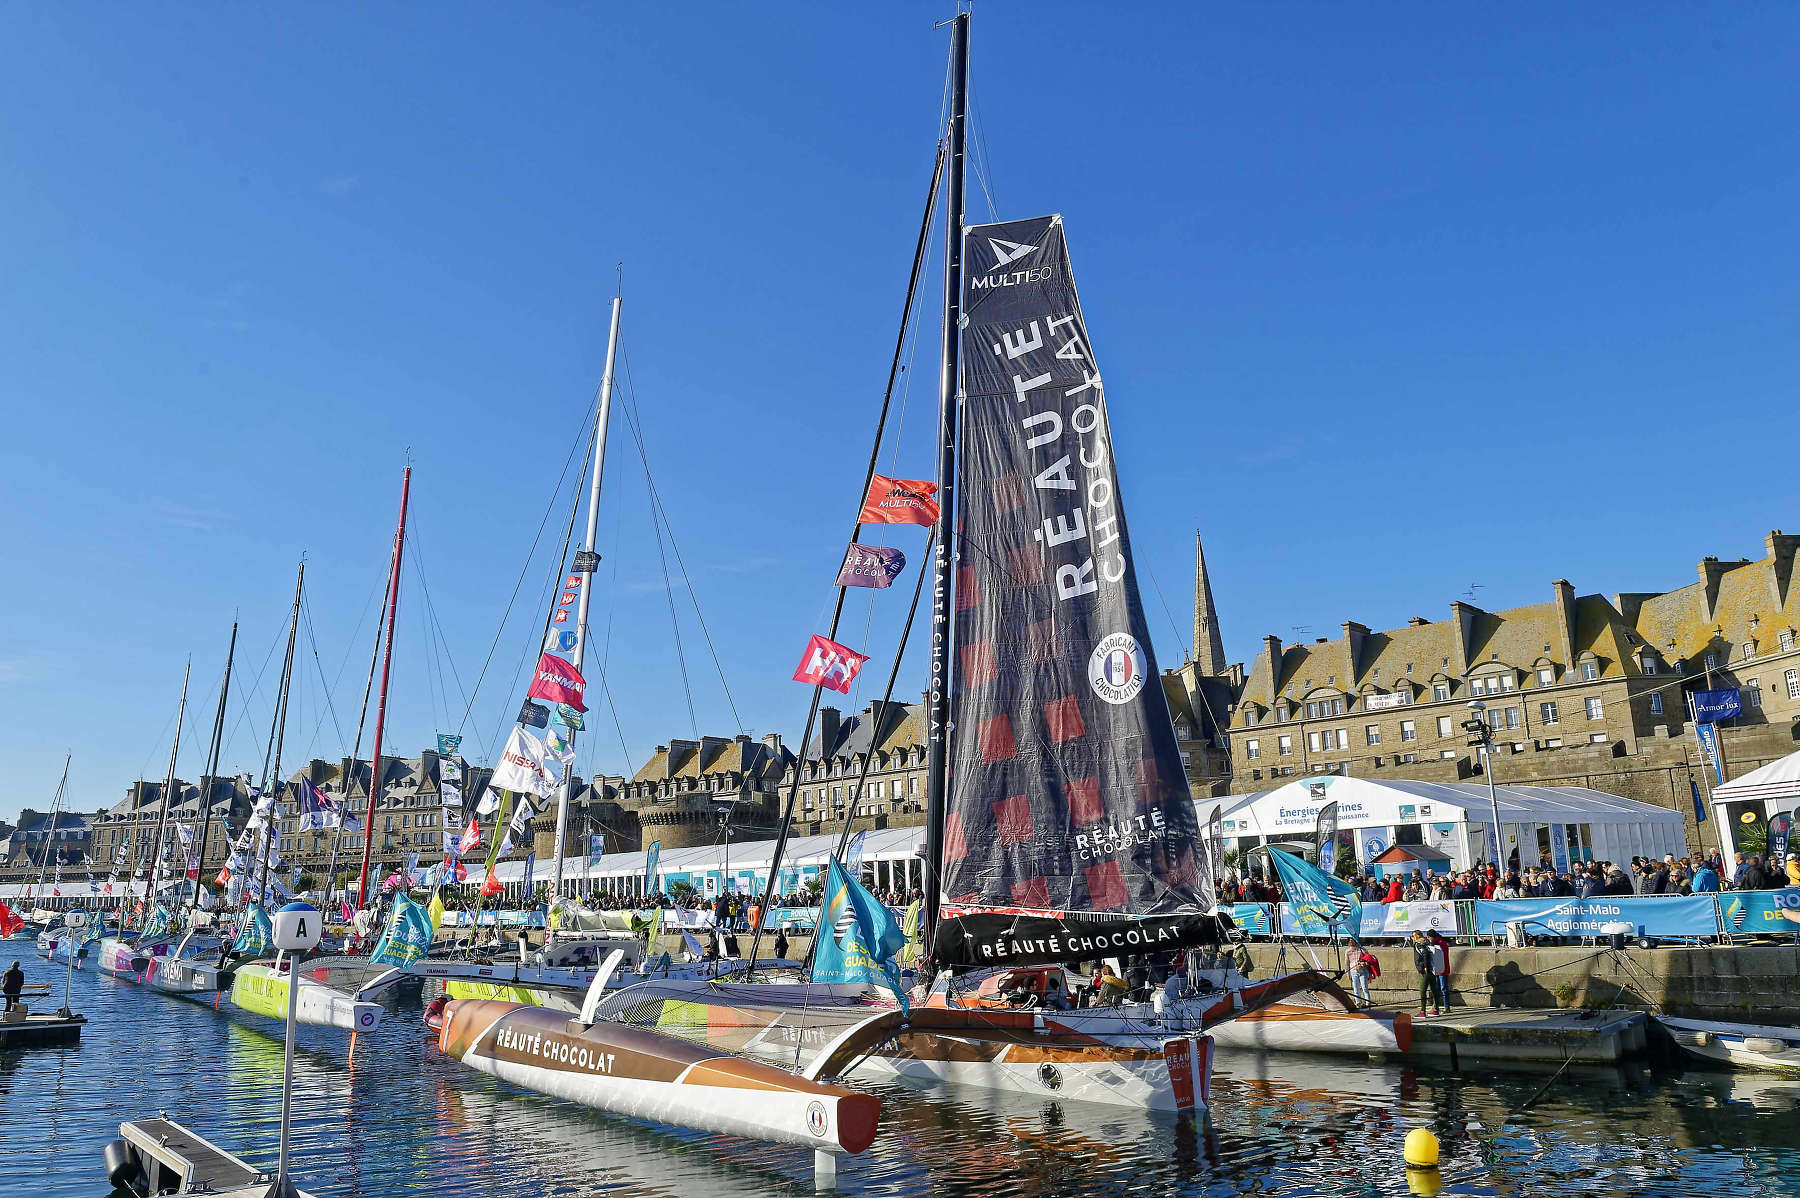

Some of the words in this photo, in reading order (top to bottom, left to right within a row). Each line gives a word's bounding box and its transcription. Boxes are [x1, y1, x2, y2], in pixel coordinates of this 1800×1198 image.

[971, 266, 1052, 290] MULTI50
[994, 320, 1098, 601] RÉAUTÉ
[1046, 314, 1127, 583] CHOCOLAT
[934, 544, 947, 624] RÉAUTÉ
[1096, 636, 1139, 660] FABRICANT
[931, 632, 943, 743] CHOCOLAT
[1095, 674, 1143, 700] CHOCOLATIER
[1075, 806, 1166, 850] RÉAUTÉ
[1275, 818, 1283, 826] La
[1284, 817, 1311, 827] Bretagne
[1279, 805, 1320, 819] Énergies
[1079, 826, 1167, 861] CHOCOLAT
[1555, 904, 1620, 916] Saint-Malo
[296, 917, 308, 938] A
[982, 934, 1061, 958] RÉAUTÉ
[1068, 925, 1181, 952] CHOCOLAT
[496, 1025, 542, 1056] RÉAUTÉ
[543, 1039, 616, 1074] CHOCOLAT
